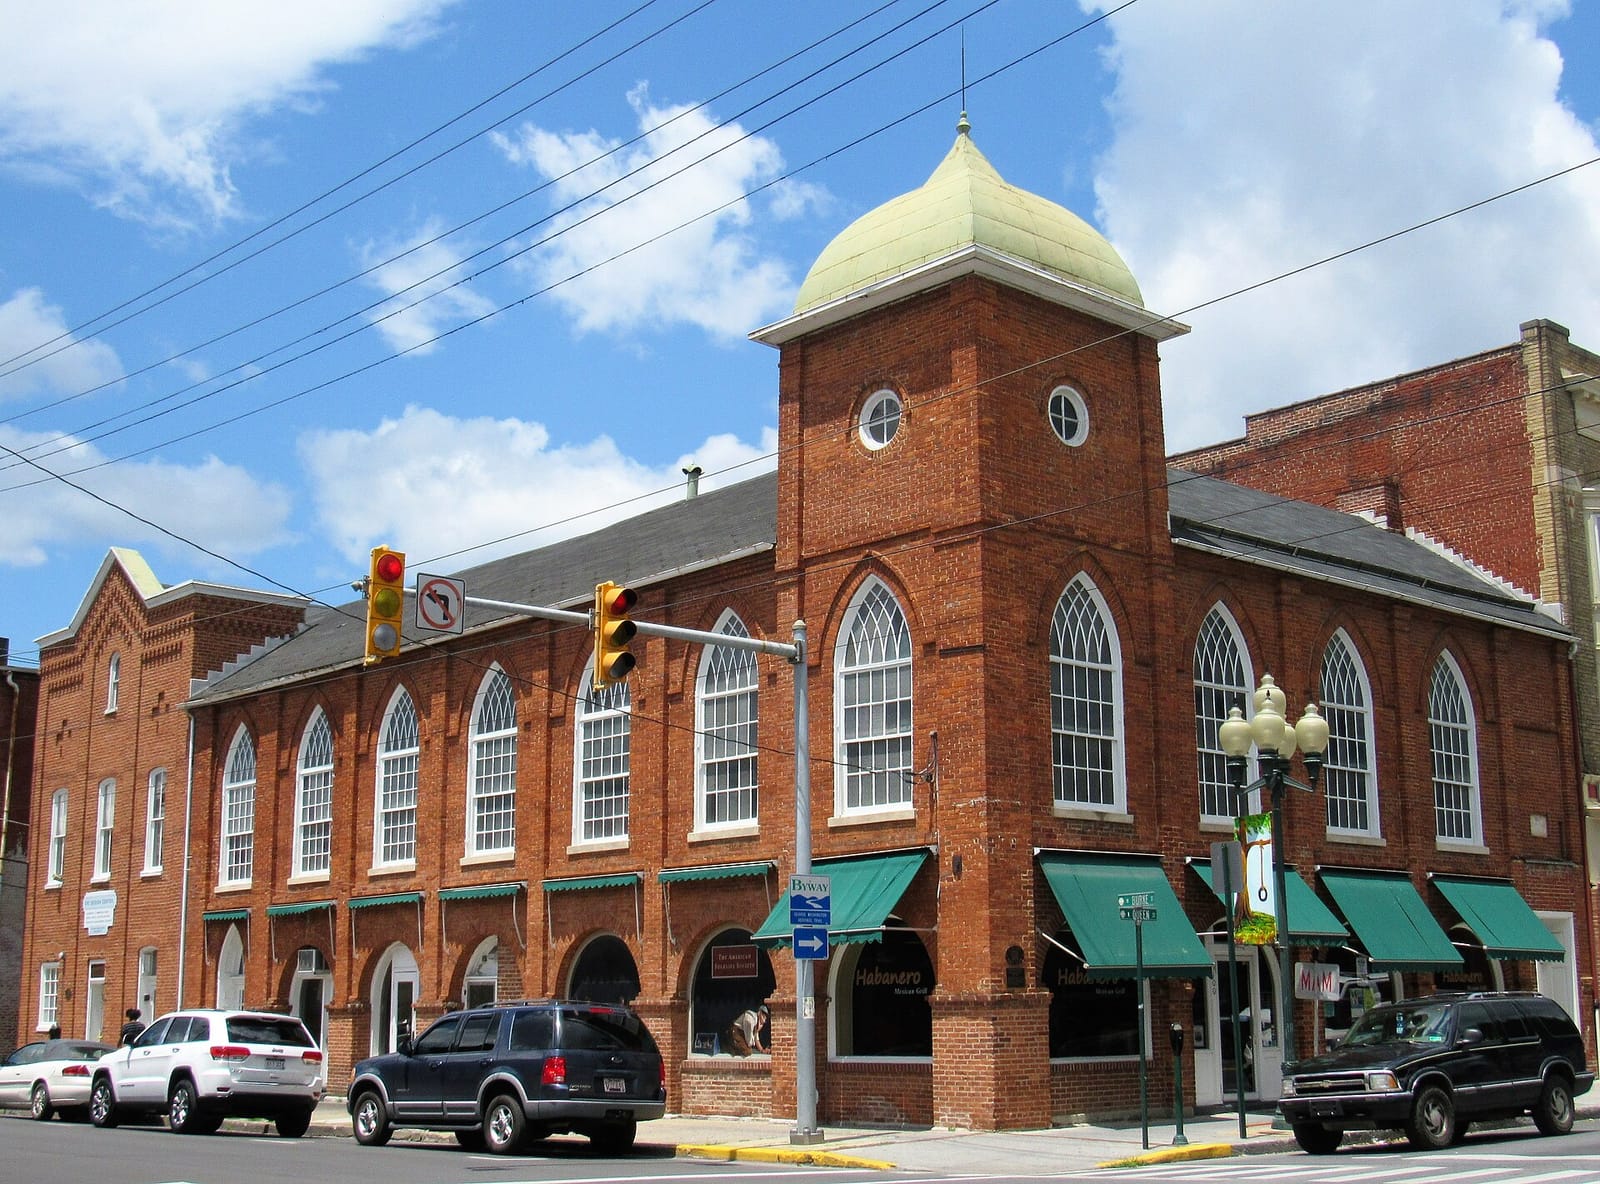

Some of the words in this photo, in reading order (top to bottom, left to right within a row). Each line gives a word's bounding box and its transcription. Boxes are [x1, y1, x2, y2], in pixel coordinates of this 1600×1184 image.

[792, 879, 829, 892] BYWAY
[1131, 894, 1149, 906] BURKE
[1132, 909, 1150, 921] QUEEN
[856, 965, 921, 986] Habanero
